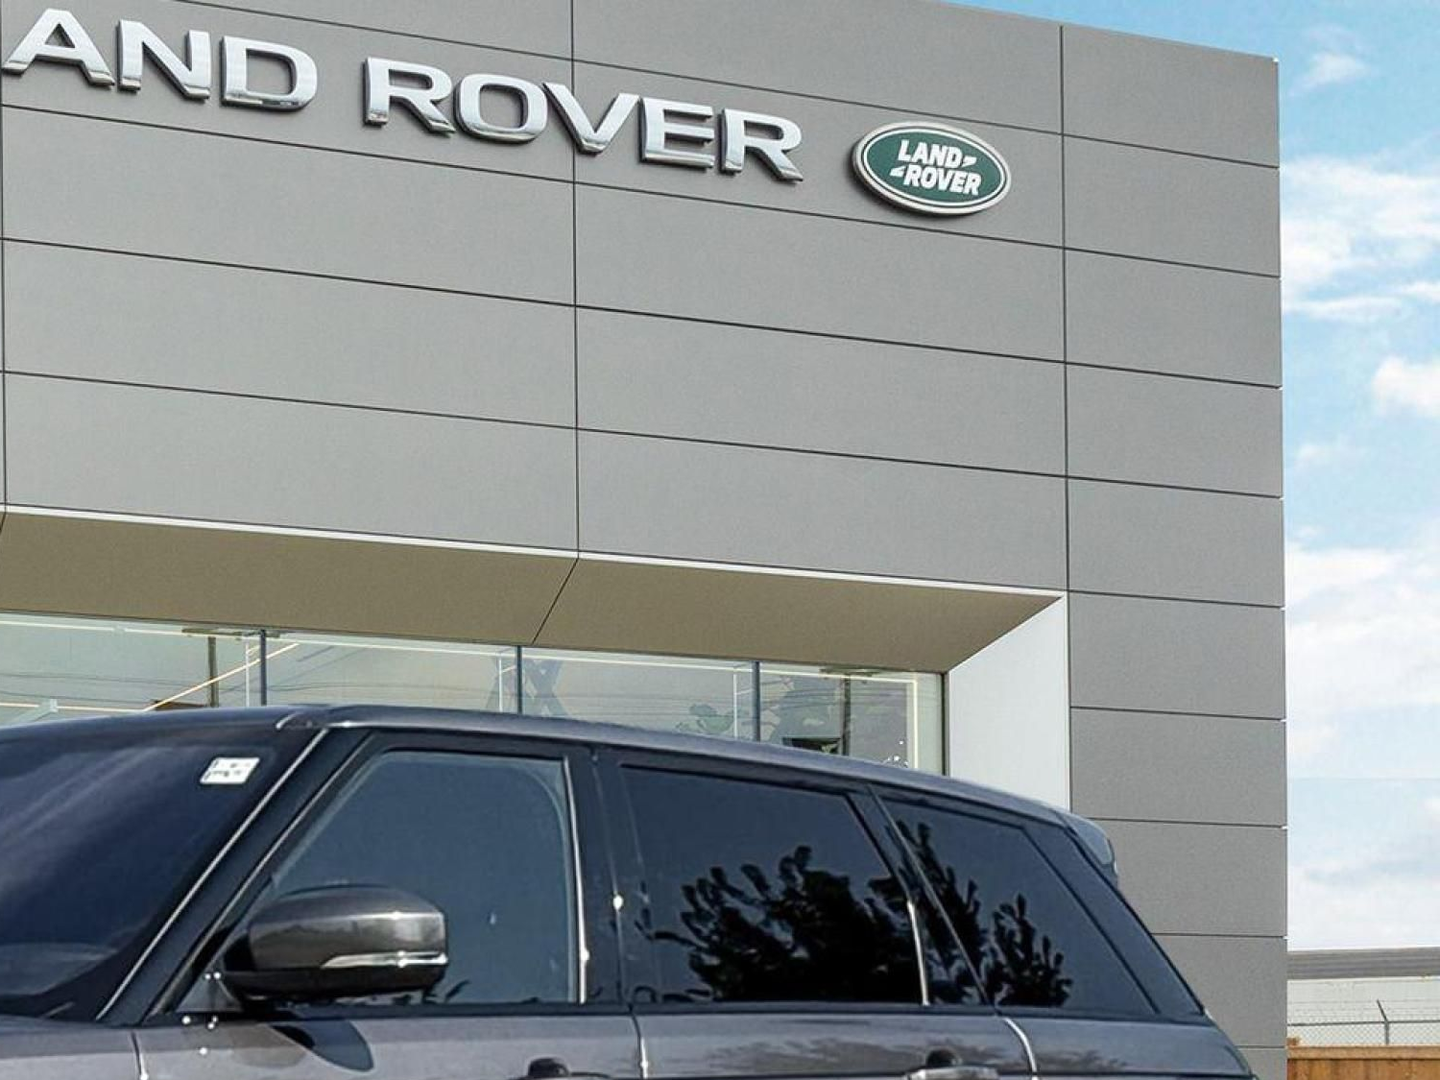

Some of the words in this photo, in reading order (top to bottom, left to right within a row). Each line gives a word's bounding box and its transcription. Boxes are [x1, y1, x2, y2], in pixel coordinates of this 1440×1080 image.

[363, 56, 804, 182] ROVER
[897, 139, 964, 169] LAND
[902, 163, 982, 196] ROVER
